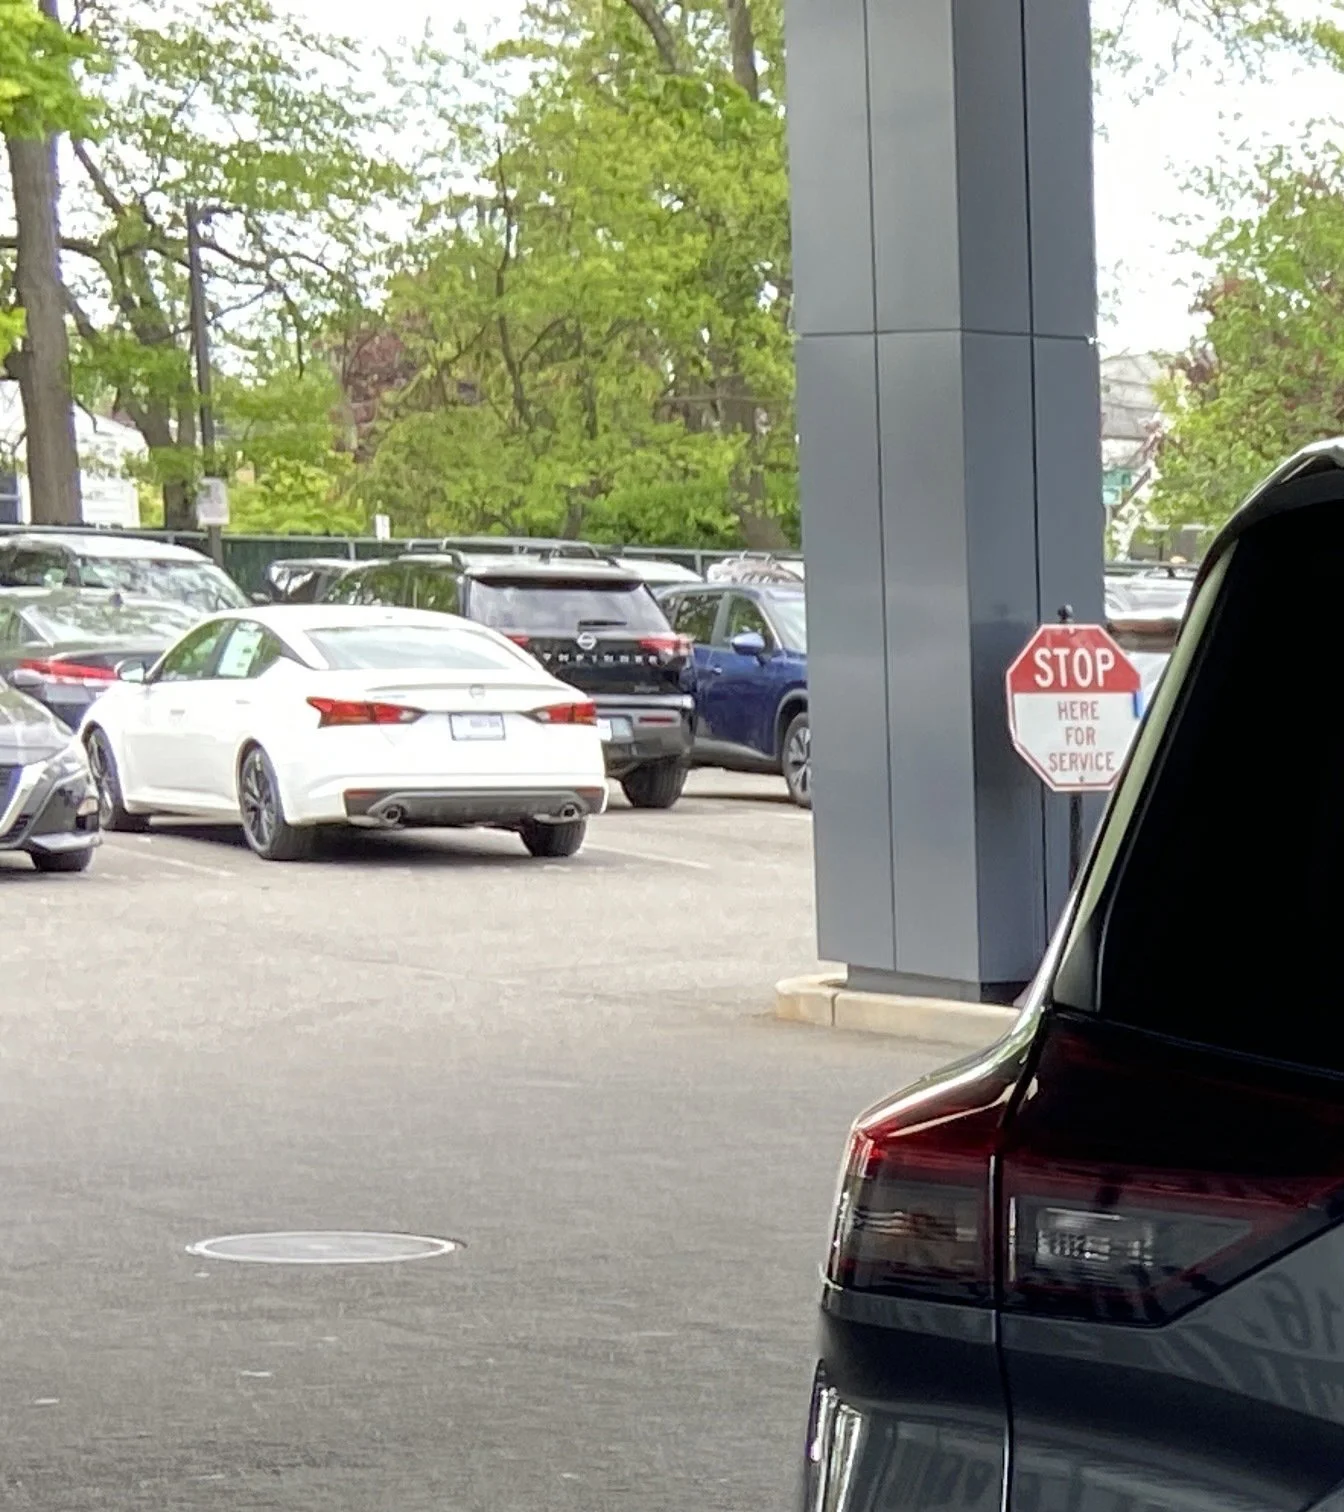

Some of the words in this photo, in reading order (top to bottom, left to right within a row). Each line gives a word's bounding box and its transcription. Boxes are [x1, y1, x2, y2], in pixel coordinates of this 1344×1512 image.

[1034, 648, 1115, 688] STOP
[1057, 701, 1100, 720] HERE
[1065, 727, 1096, 746] FOR
[1048, 752, 1115, 772] SERVICE
